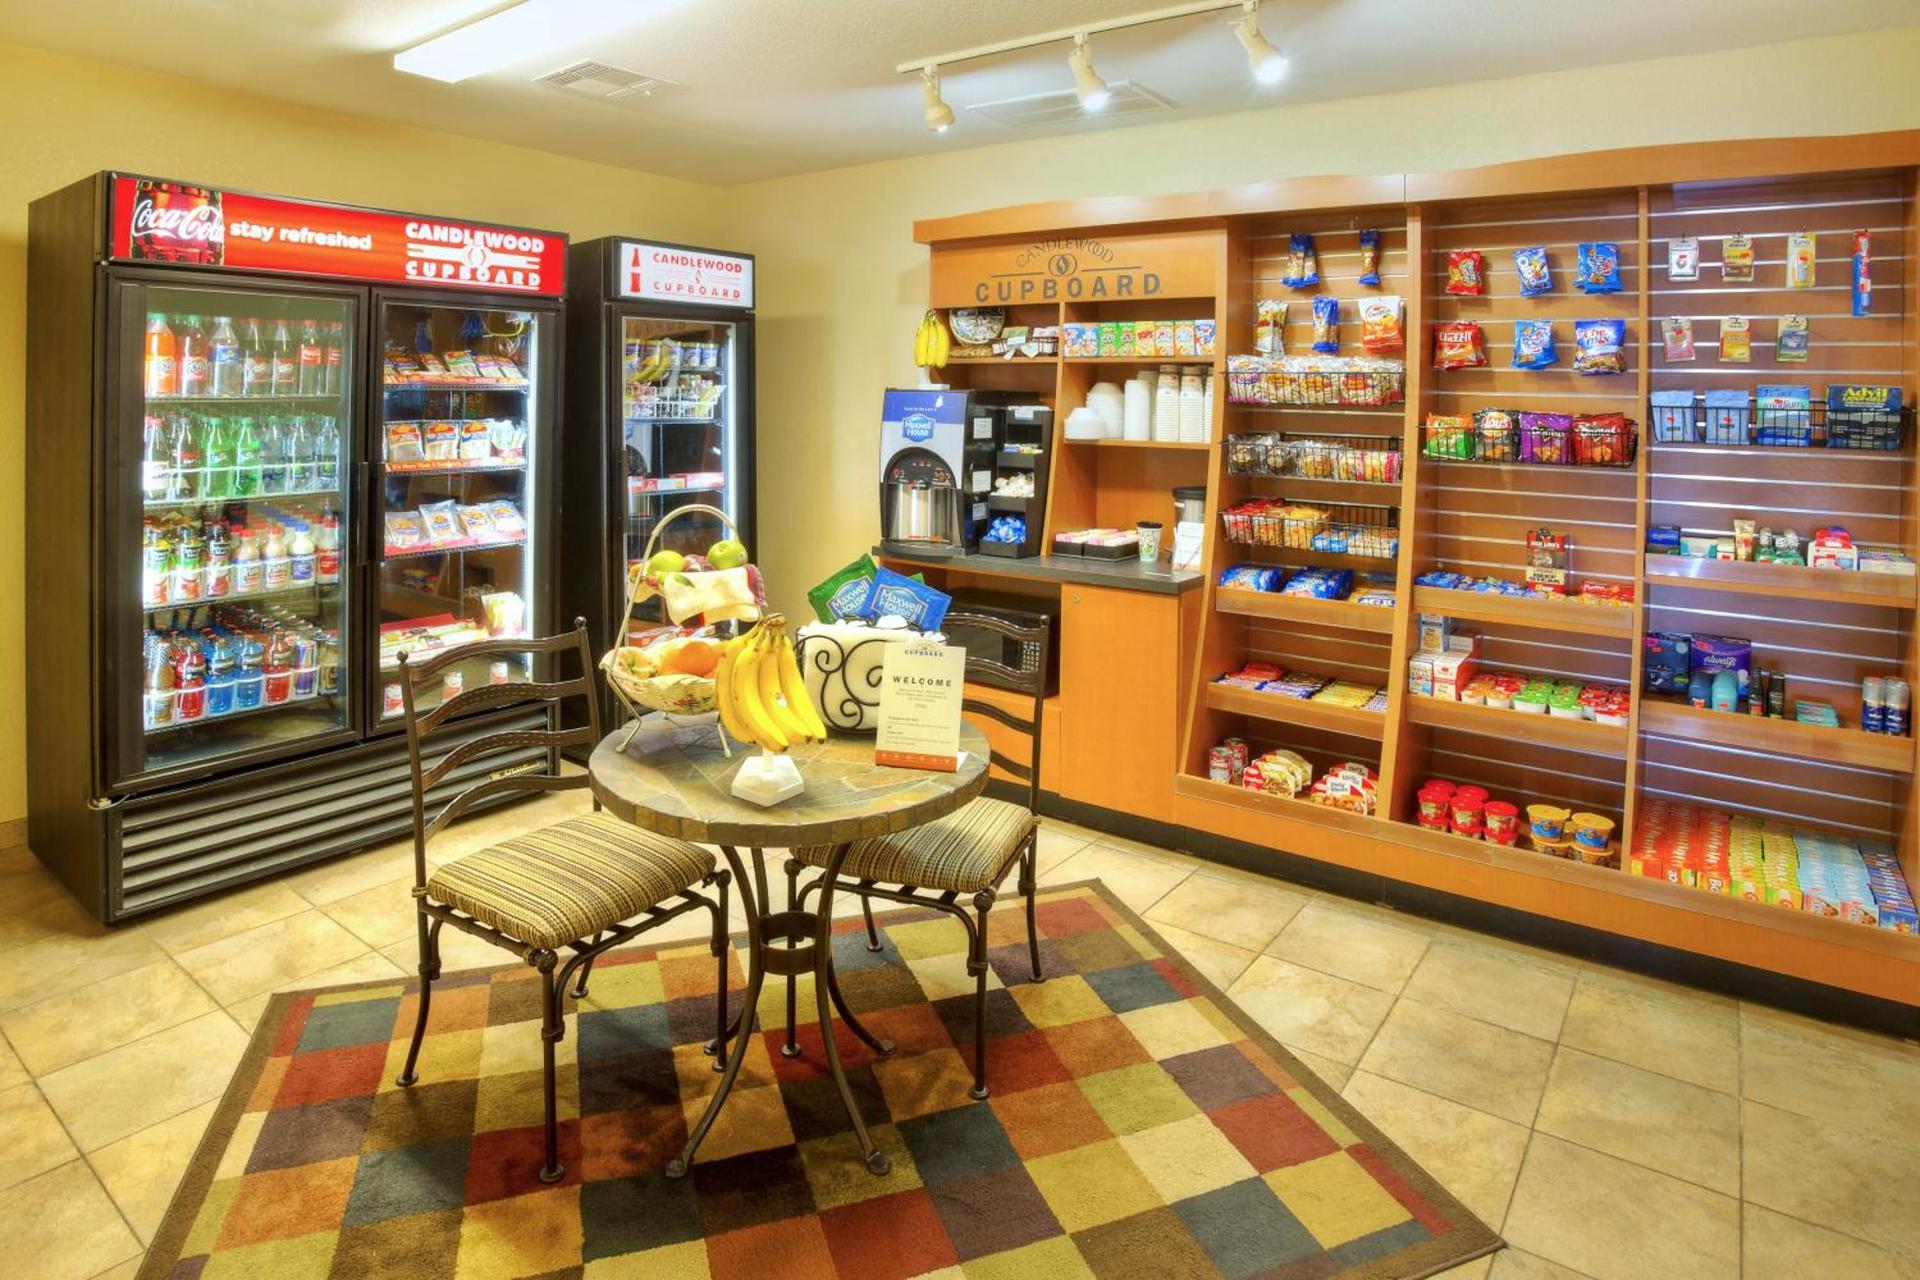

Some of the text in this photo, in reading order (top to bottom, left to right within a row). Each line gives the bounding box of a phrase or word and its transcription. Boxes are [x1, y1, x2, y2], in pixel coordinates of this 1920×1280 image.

[132, 199, 225, 244] Coca-Cola
[230, 221, 372, 251] stay refreshed
[405, 222, 545, 253] CANDLEWOOD
[1015, 236, 1114, 267] CANDLEWOOD
[405, 260, 541, 287] CUPBOARD
[653, 252, 742, 274] CANDLEWOOD
[653, 281, 741, 299] CUPBOARD
[975, 273, 1161, 303] CUPBOARD
[831, 579, 870, 609] Maxwell
[880, 588, 922, 614] Maxwell
[893, 675, 952, 687] WELCOME
